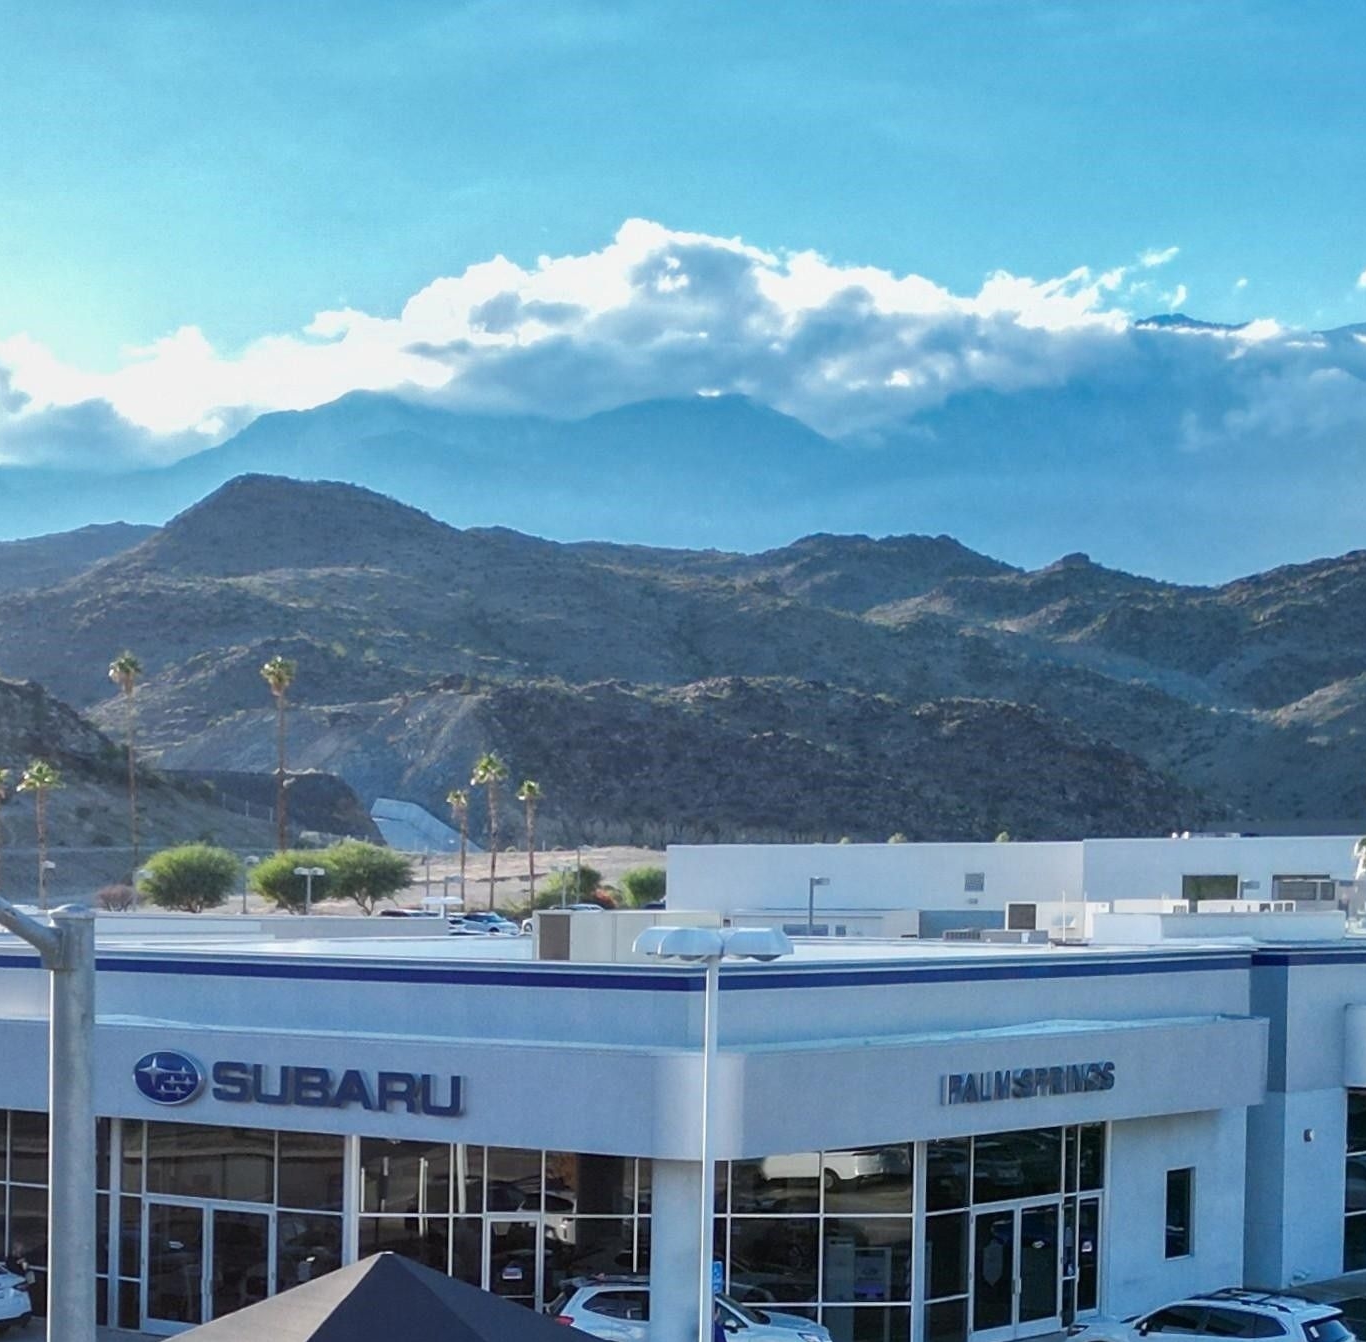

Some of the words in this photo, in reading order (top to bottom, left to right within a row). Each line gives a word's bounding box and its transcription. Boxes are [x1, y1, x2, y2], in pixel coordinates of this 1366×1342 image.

[212, 1061, 464, 1117] SUBARU
[940, 1070, 1011, 1105] PALM
[1012, 1061, 1115, 1099] SPRINGS
